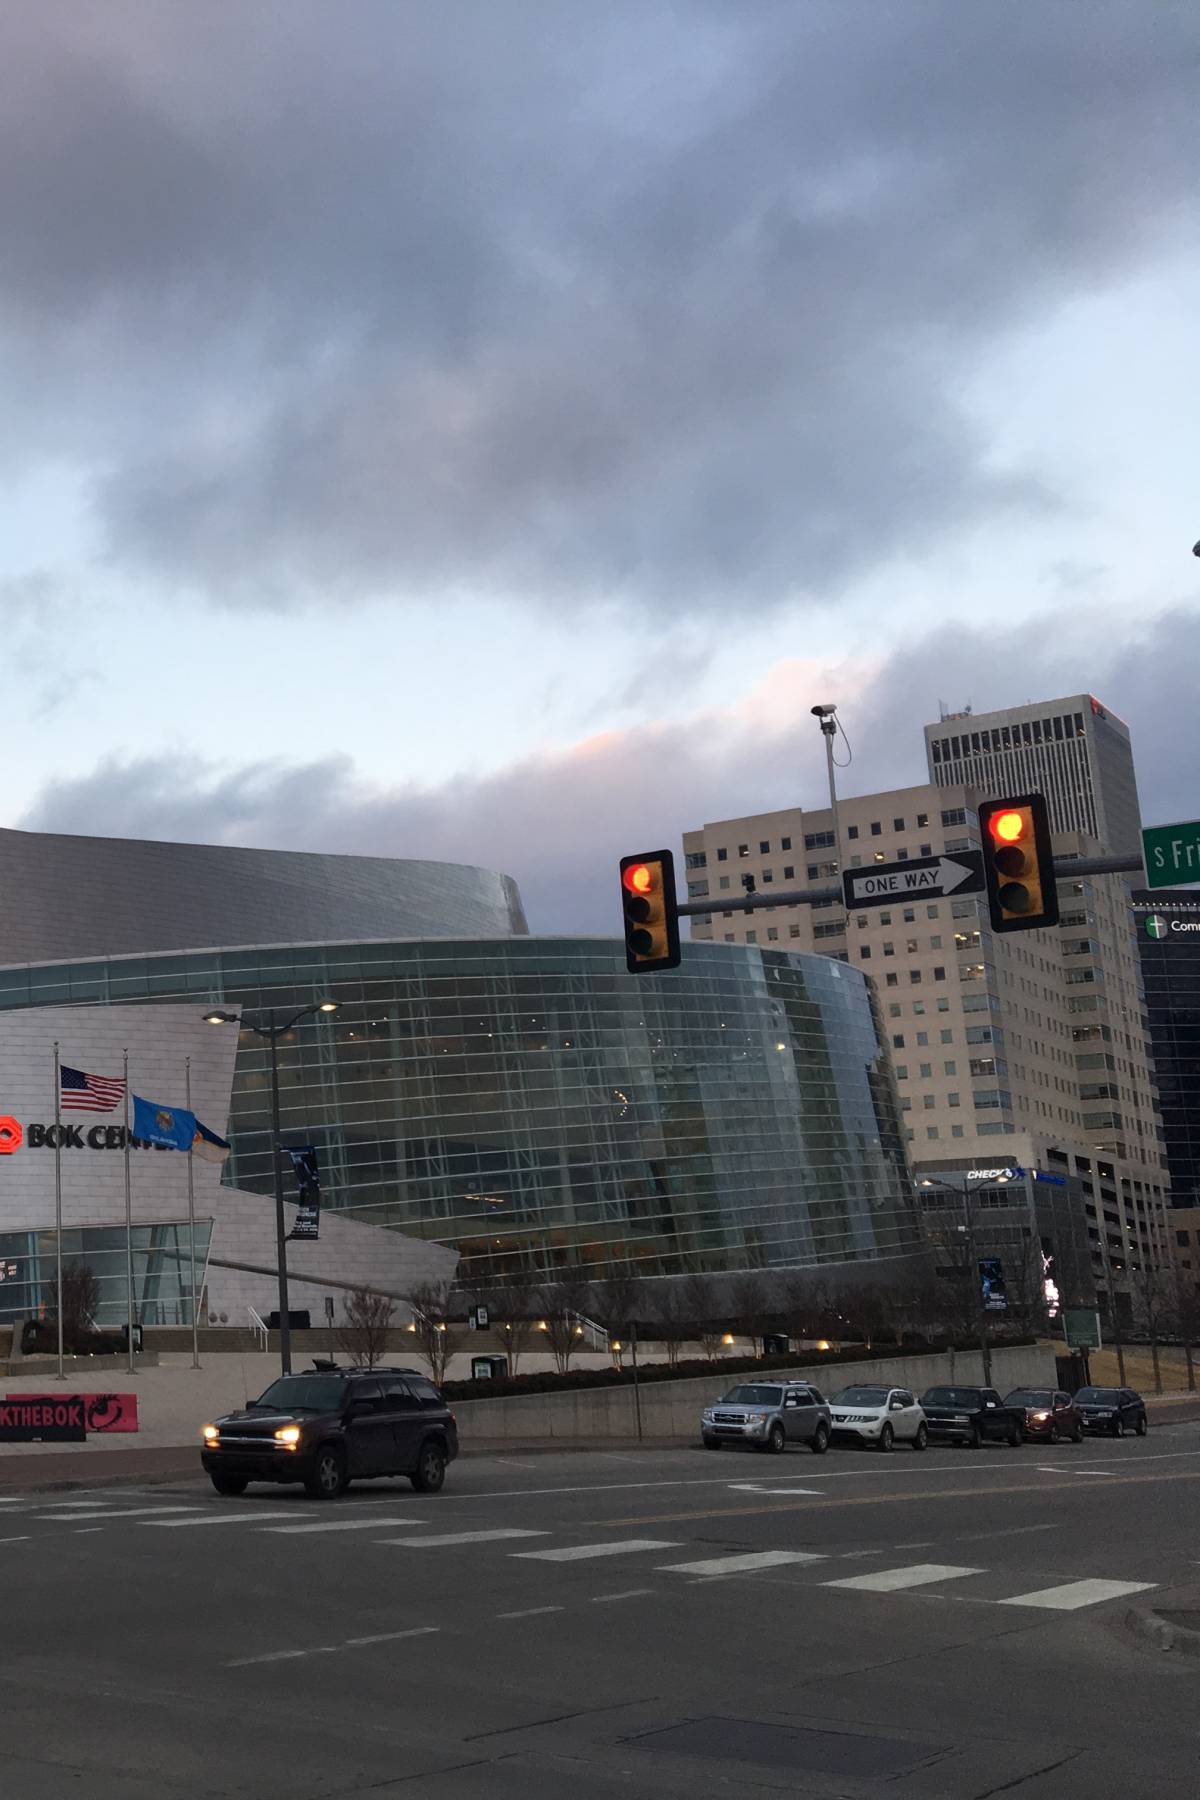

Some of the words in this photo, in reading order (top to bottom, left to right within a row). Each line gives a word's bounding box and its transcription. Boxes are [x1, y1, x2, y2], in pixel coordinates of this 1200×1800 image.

[865, 876, 898, 893] ONE
[905, 870, 939, 887] WAY
[1171, 920, 1200, 931] Com
[28, 1123, 85, 1149] BOK
